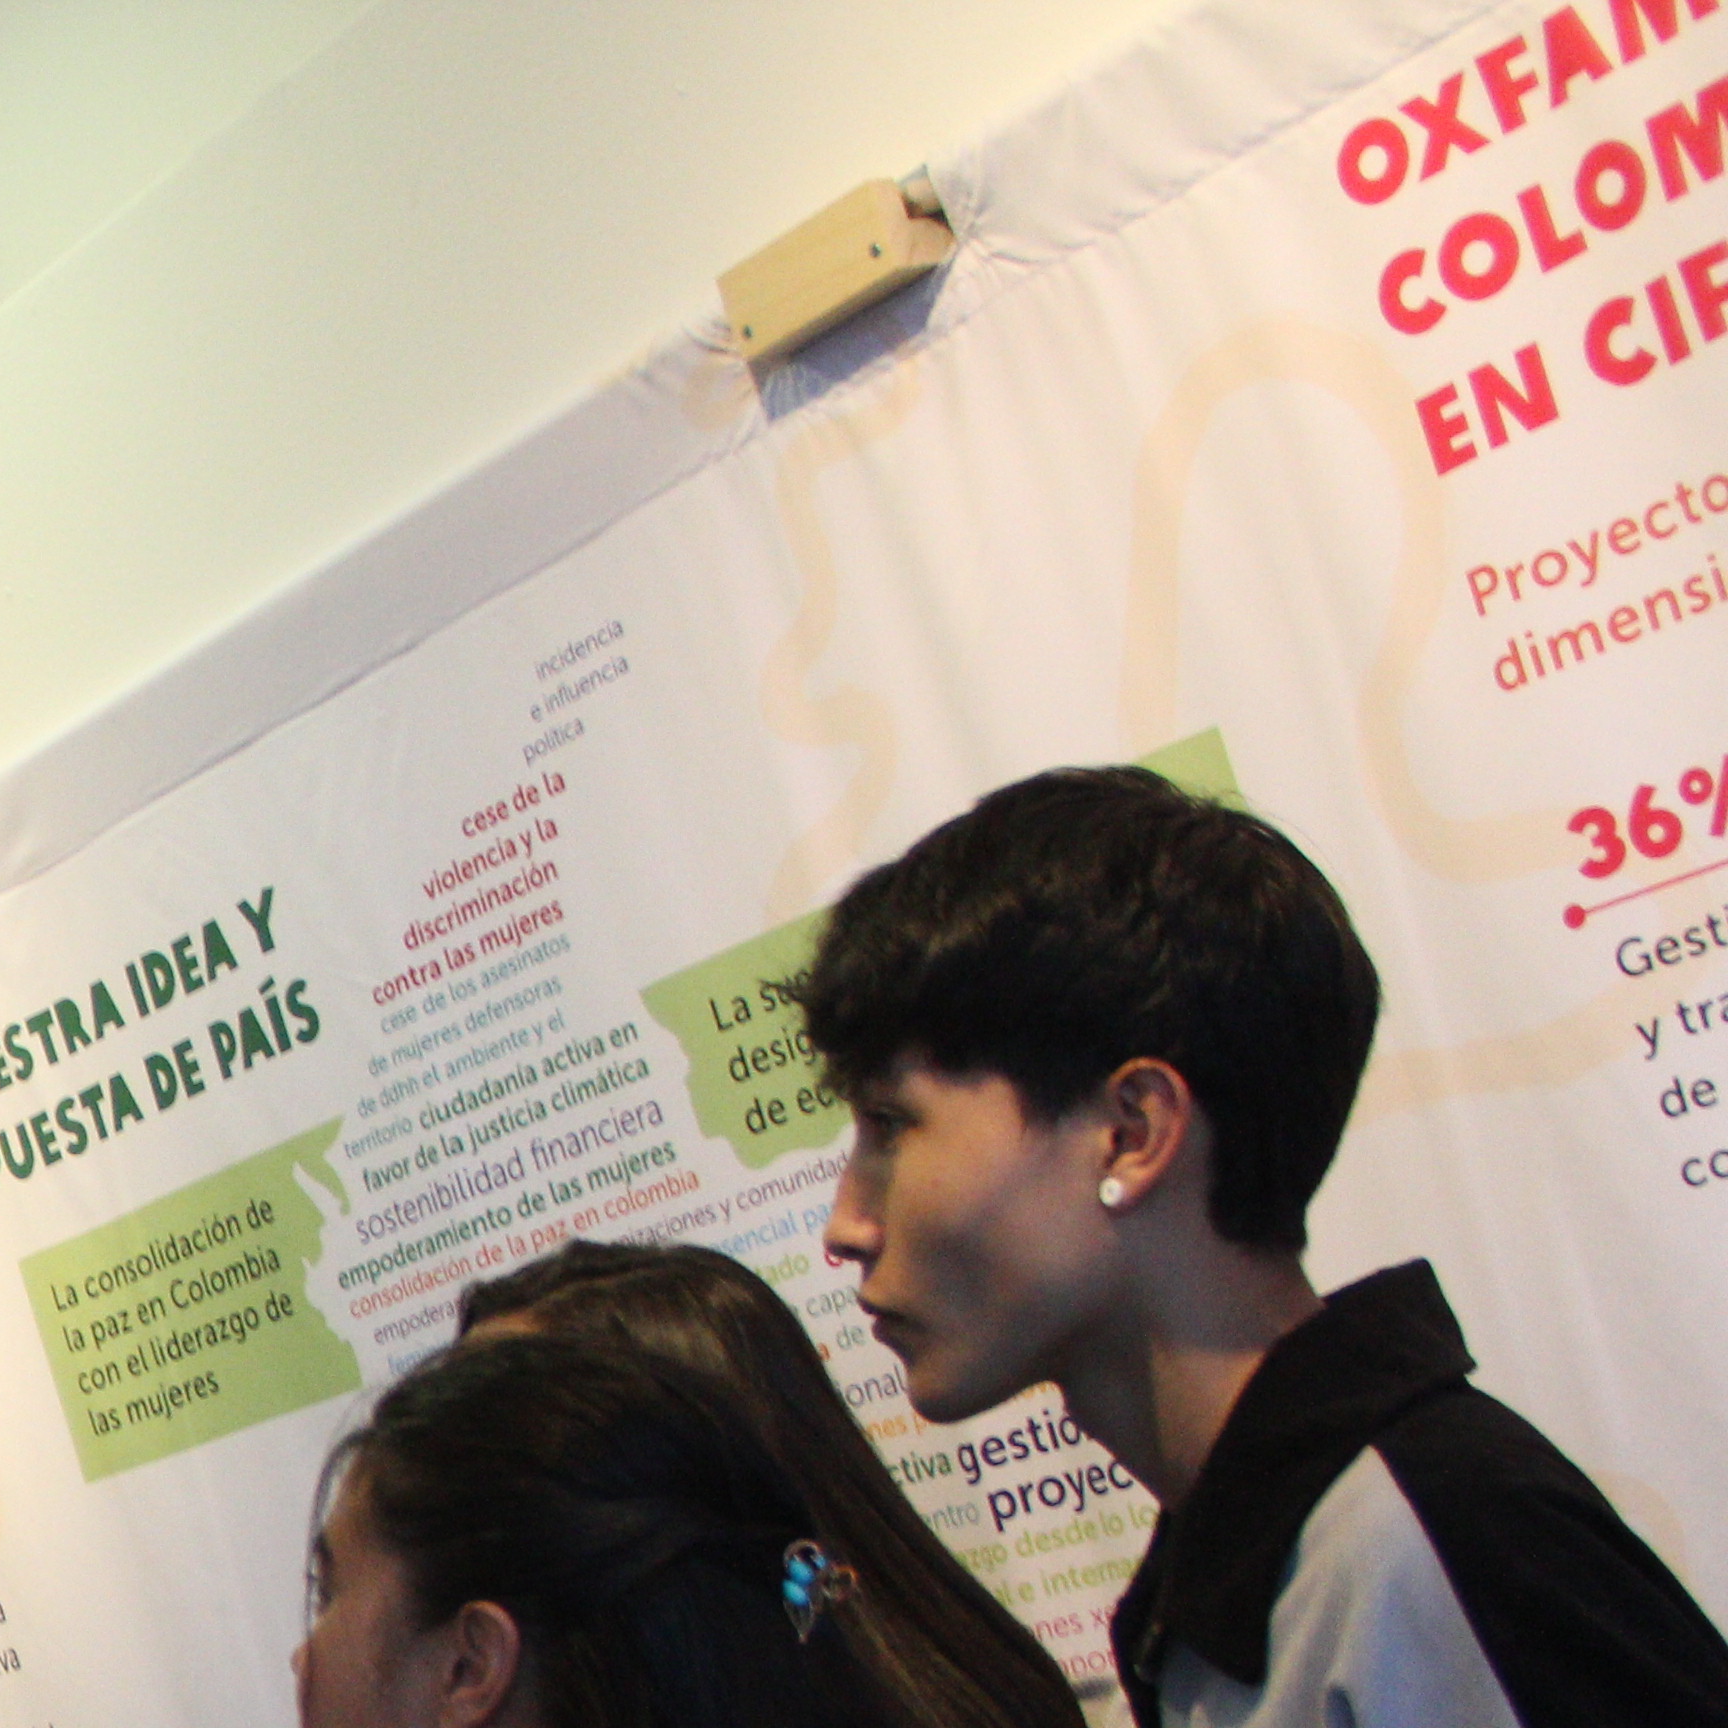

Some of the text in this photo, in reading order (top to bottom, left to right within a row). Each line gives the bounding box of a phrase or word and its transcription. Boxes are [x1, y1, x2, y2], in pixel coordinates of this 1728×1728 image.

[1336, 0, 1720, 206] OXFAM
[1415, 342, 1560, 477] EN
[535, 618, 624, 681] incidencia
[544, 654, 630, 712] influencia
[521, 717, 585, 766] política
[462, 785, 540, 837] cese de
[404, 861, 558, 950] discriminación
[423, 838, 518, 899] violencia
[125, 920, 238, 1018] IDEA
[237, 888, 275, 953] Y
[373, 900, 564, 1005] contra las mujeres
[481, 935, 570, 989] asesinatos
[144, 1039, 205, 1111] DE
[208, 977, 320, 1080] PAÍS
[391, 977, 562, 1065] mujeres defensoras
[445, 1029, 529, 1079] ambiente
[709, 997, 752, 1032] La
[344, 1023, 638, 1160] territorio ciudadanía activa en
[363, 1058, 650, 1192] favor justicia climática
[745, 1098, 787, 1135] de
[1659, 1076, 1717, 1118] de
[338, 1142, 676, 1290] empoderamiento de las mujeres
[356, 1100, 664, 1245] sostenibilidad financiera
[51, 1200, 274, 1311] La consolidación de
[350, 1171, 700, 1319] consolidación colombia
[78, 1292, 293, 1395] con liderazgo de
[90, 1249, 281, 1350] paz en Colombia
[88, 1371, 219, 1436] las mujeres
